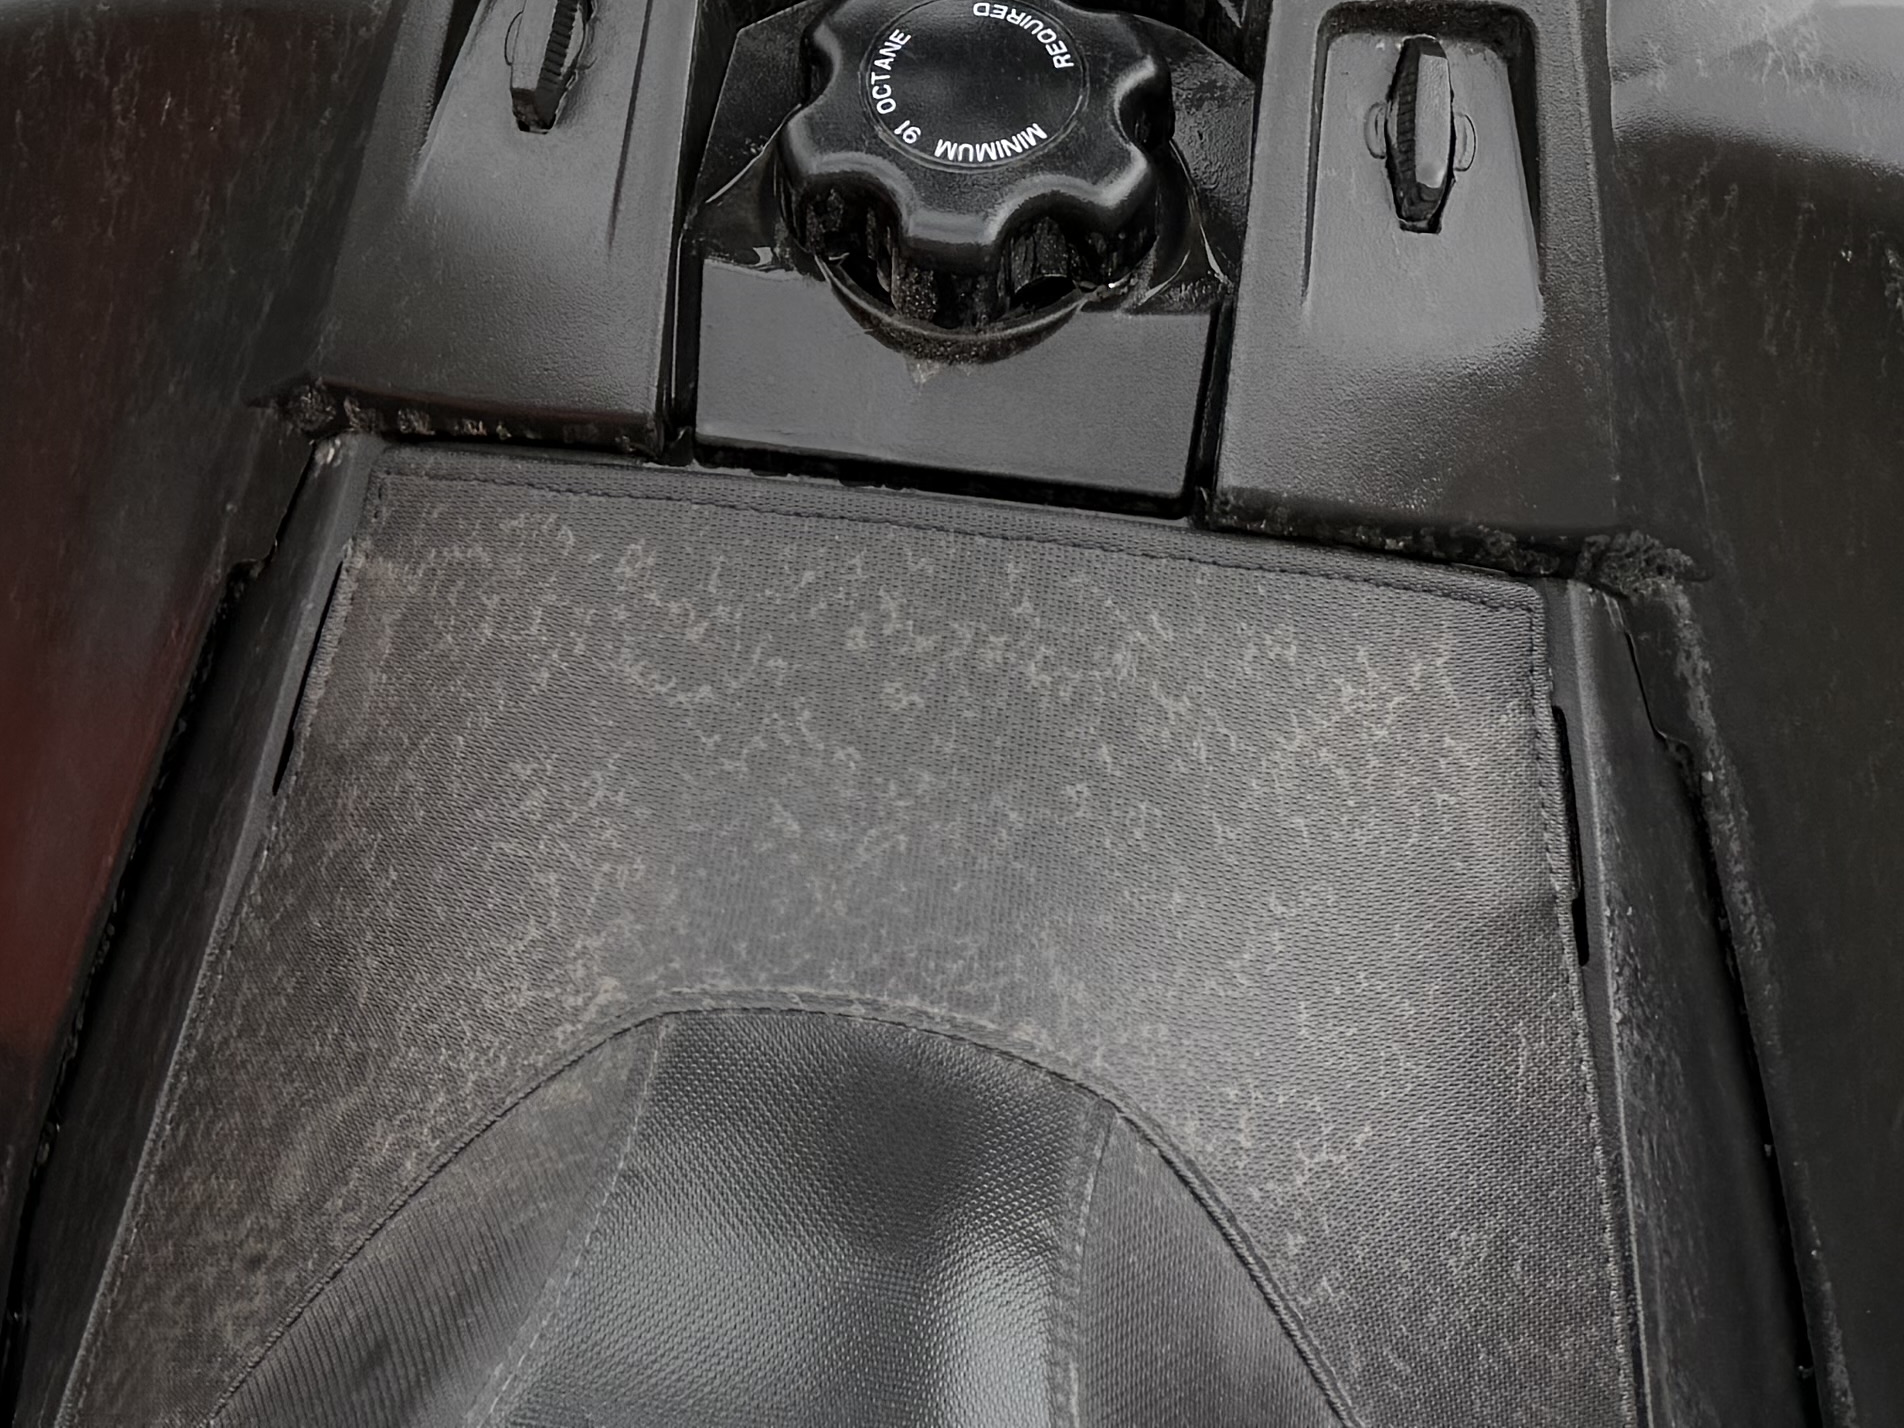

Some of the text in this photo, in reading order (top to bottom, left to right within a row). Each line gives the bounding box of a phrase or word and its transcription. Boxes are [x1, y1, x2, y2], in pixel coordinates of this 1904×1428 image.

[972, 1, 1075, 70] REQUIRED
[871, 29, 1048, 163] MINIMUM 91 OCTANE
